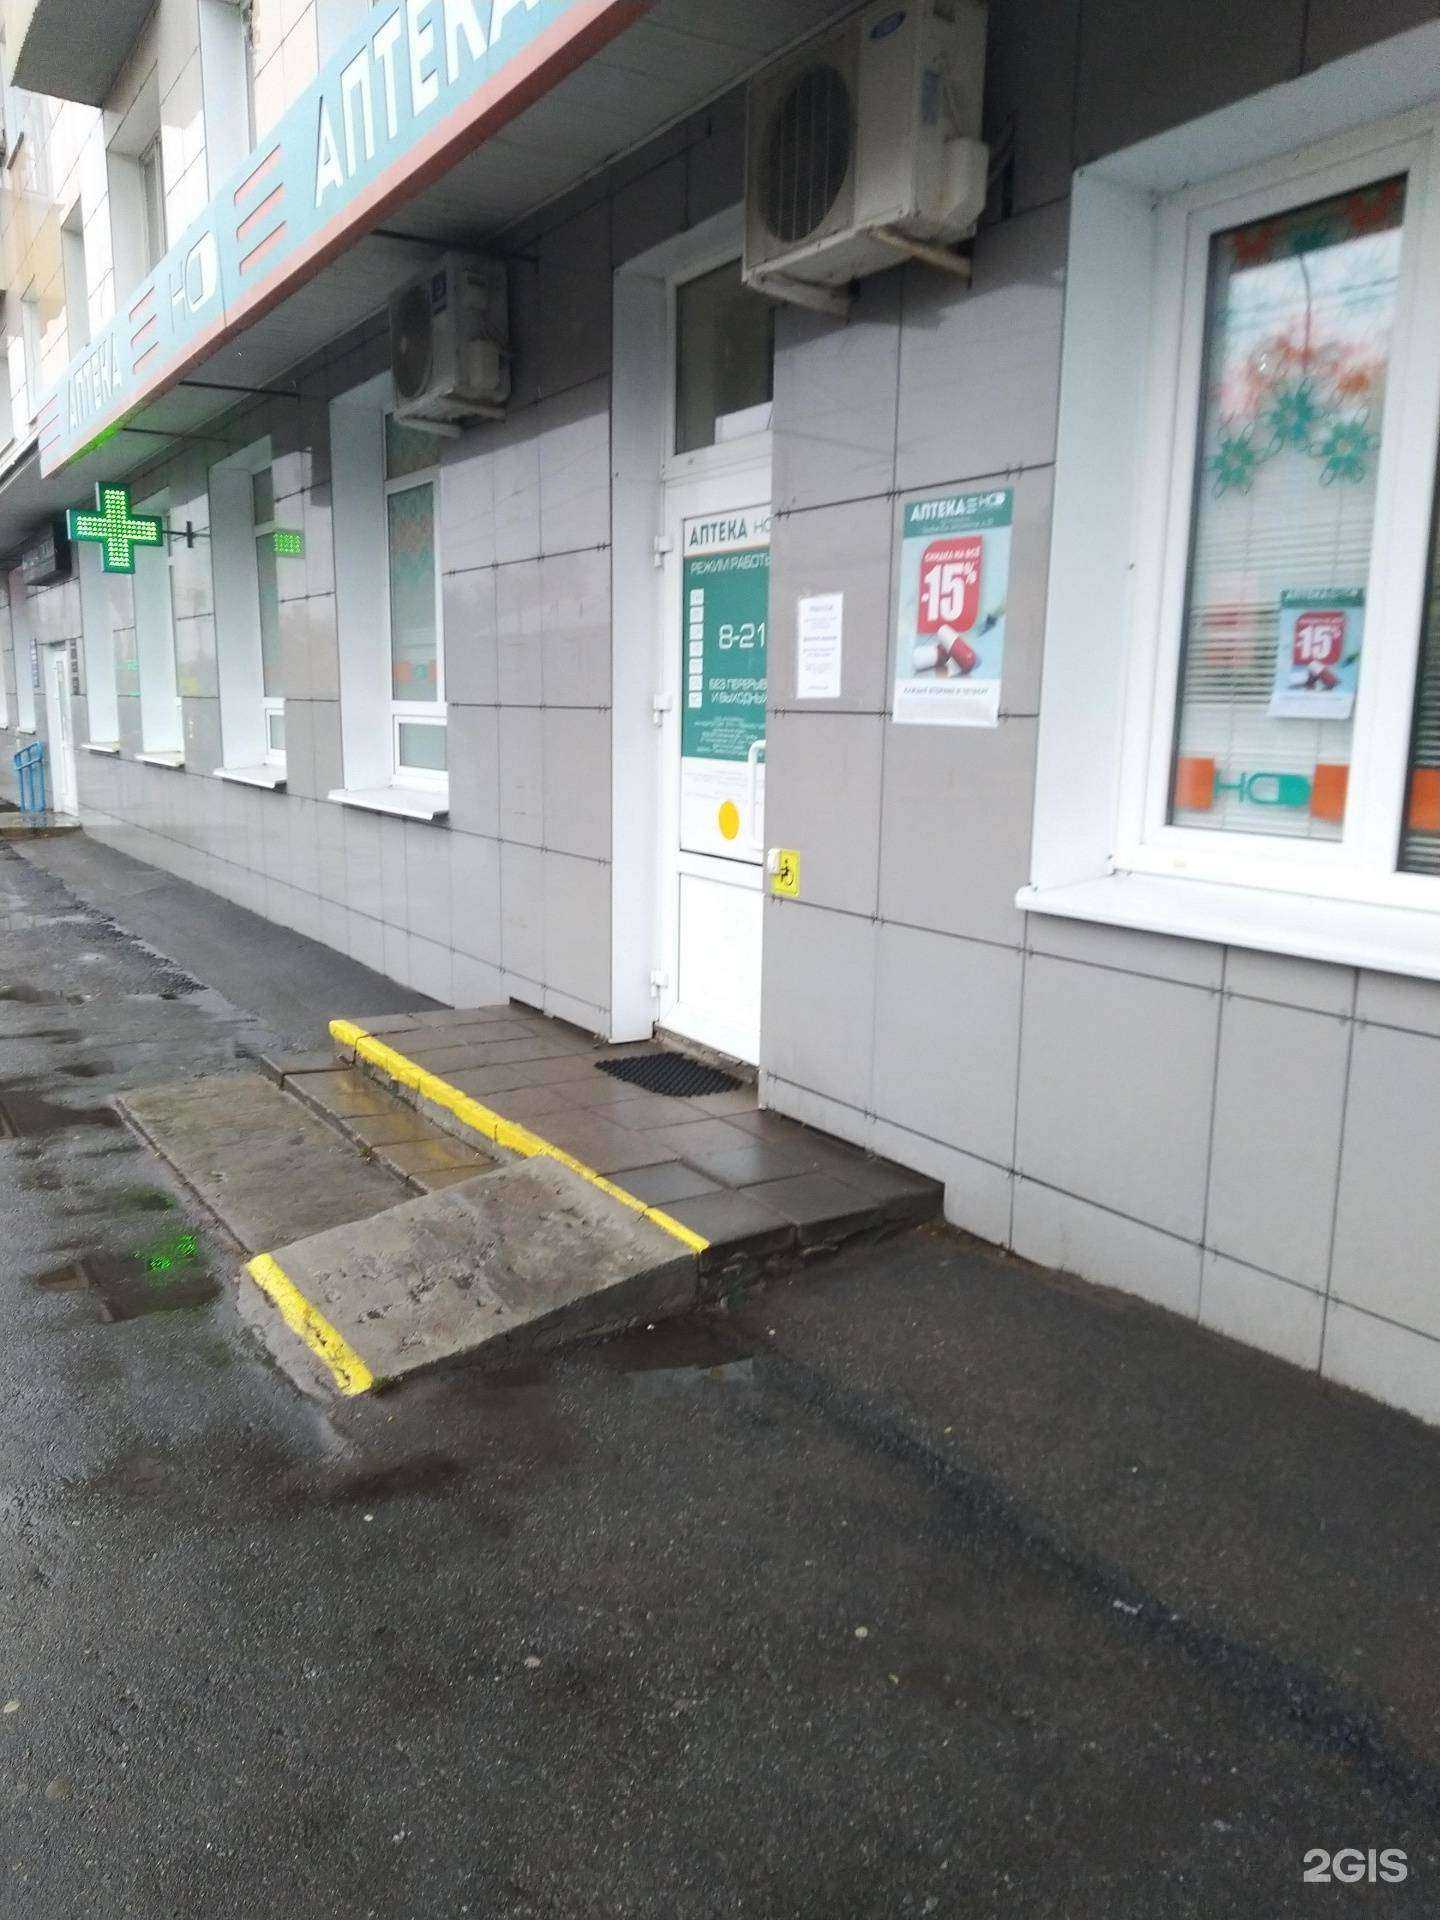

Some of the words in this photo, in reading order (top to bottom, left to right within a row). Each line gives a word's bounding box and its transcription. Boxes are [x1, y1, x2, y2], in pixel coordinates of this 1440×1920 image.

[67, 330, 122, 435] АПТЕКА
[910, 498, 966, 522] АПТЕКА
[689, 518, 748, 546] АПТЕКА
[690, 557, 729, 575] РЕЖИМ
[719, 622, 766, 649] 8-21
[727, 678, 768, 691] ПЕРЕРЫВ
